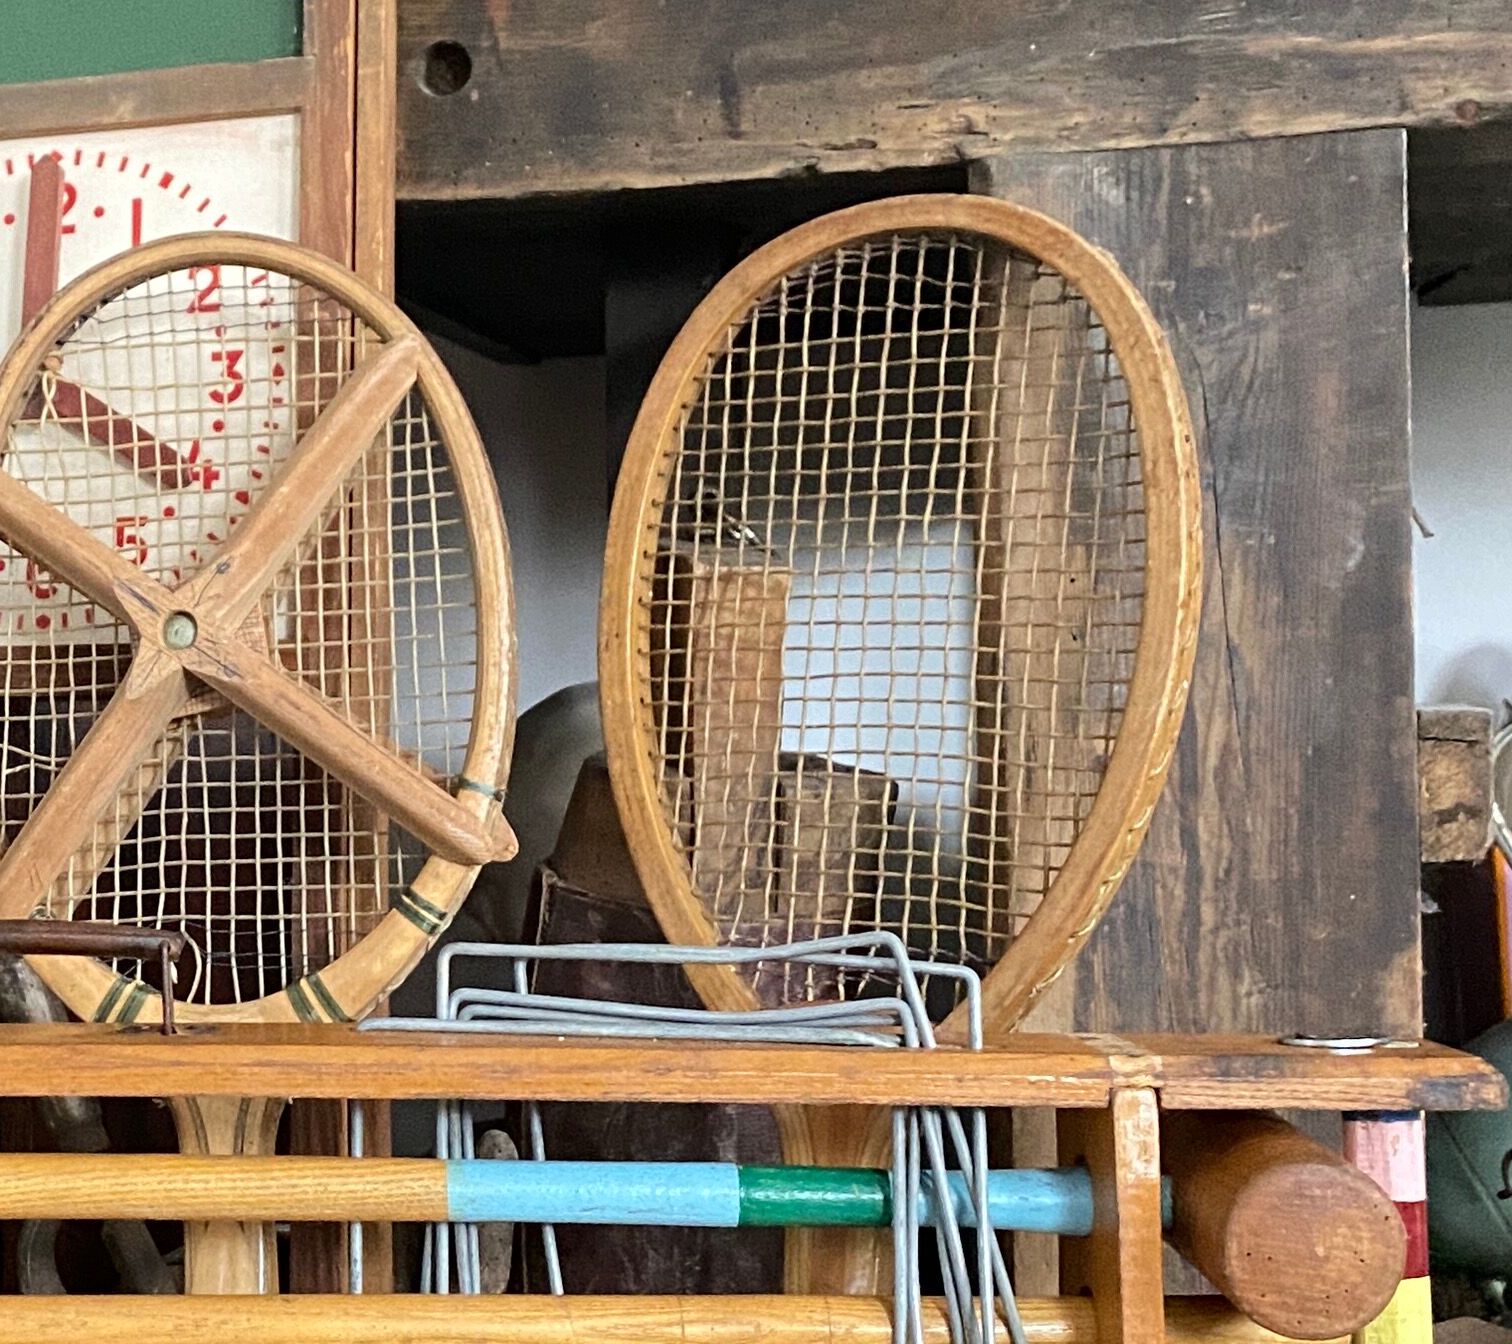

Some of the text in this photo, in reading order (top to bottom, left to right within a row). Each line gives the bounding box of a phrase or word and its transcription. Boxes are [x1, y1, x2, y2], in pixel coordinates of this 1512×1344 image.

[187, 265, 222, 314] 2
[208, 349, 245, 405] 3
[189, 439, 221, 491] 4
[115, 515, 149, 566] 5
